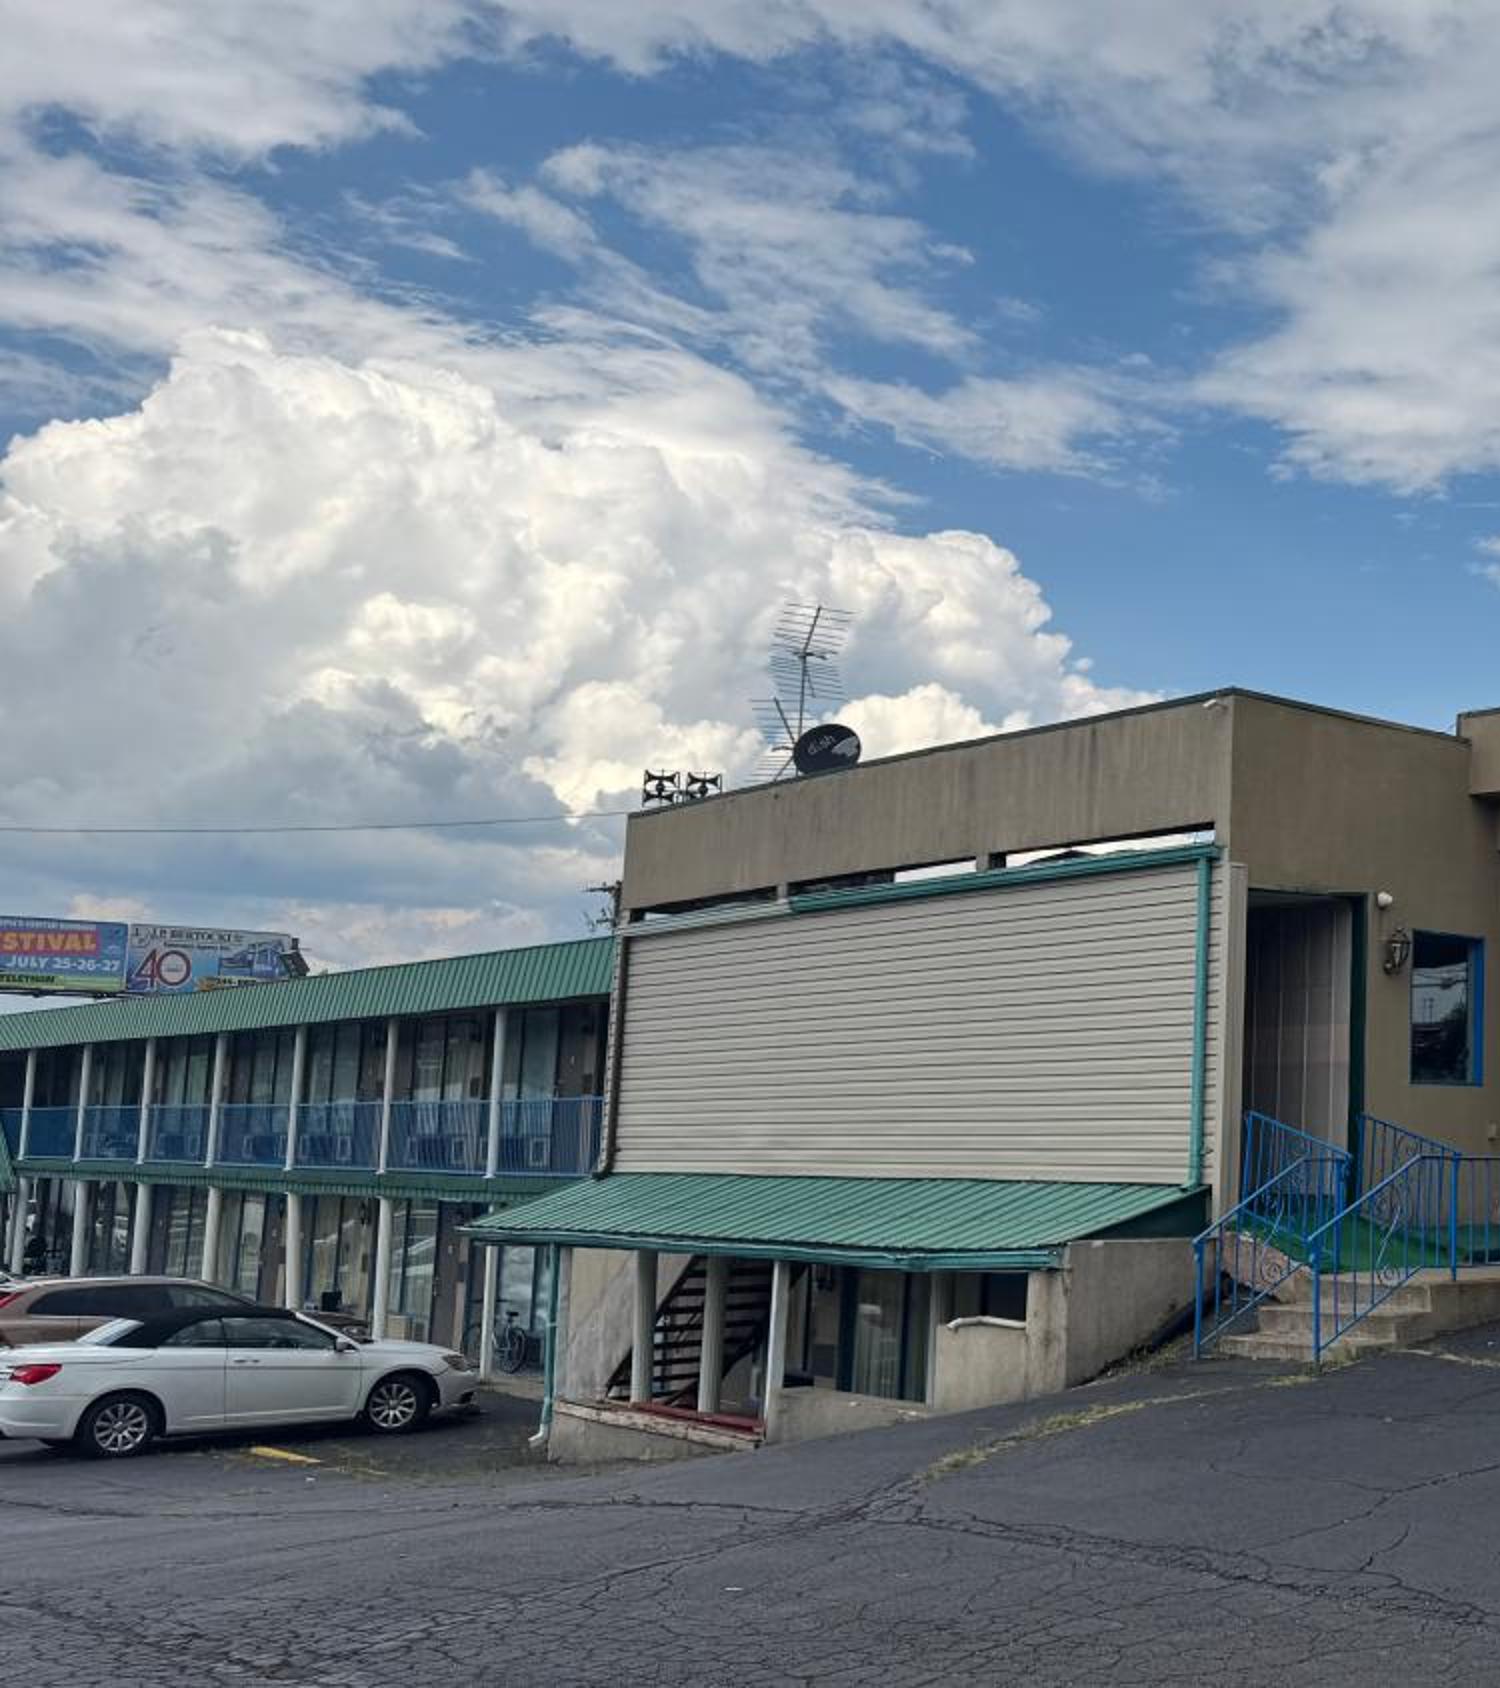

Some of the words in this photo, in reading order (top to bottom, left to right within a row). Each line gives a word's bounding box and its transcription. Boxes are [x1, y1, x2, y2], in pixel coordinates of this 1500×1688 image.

[2, 932, 97, 951] STIVAL
[6, 955, 49, 969] JULY
[134, 949, 192, 987] 40
